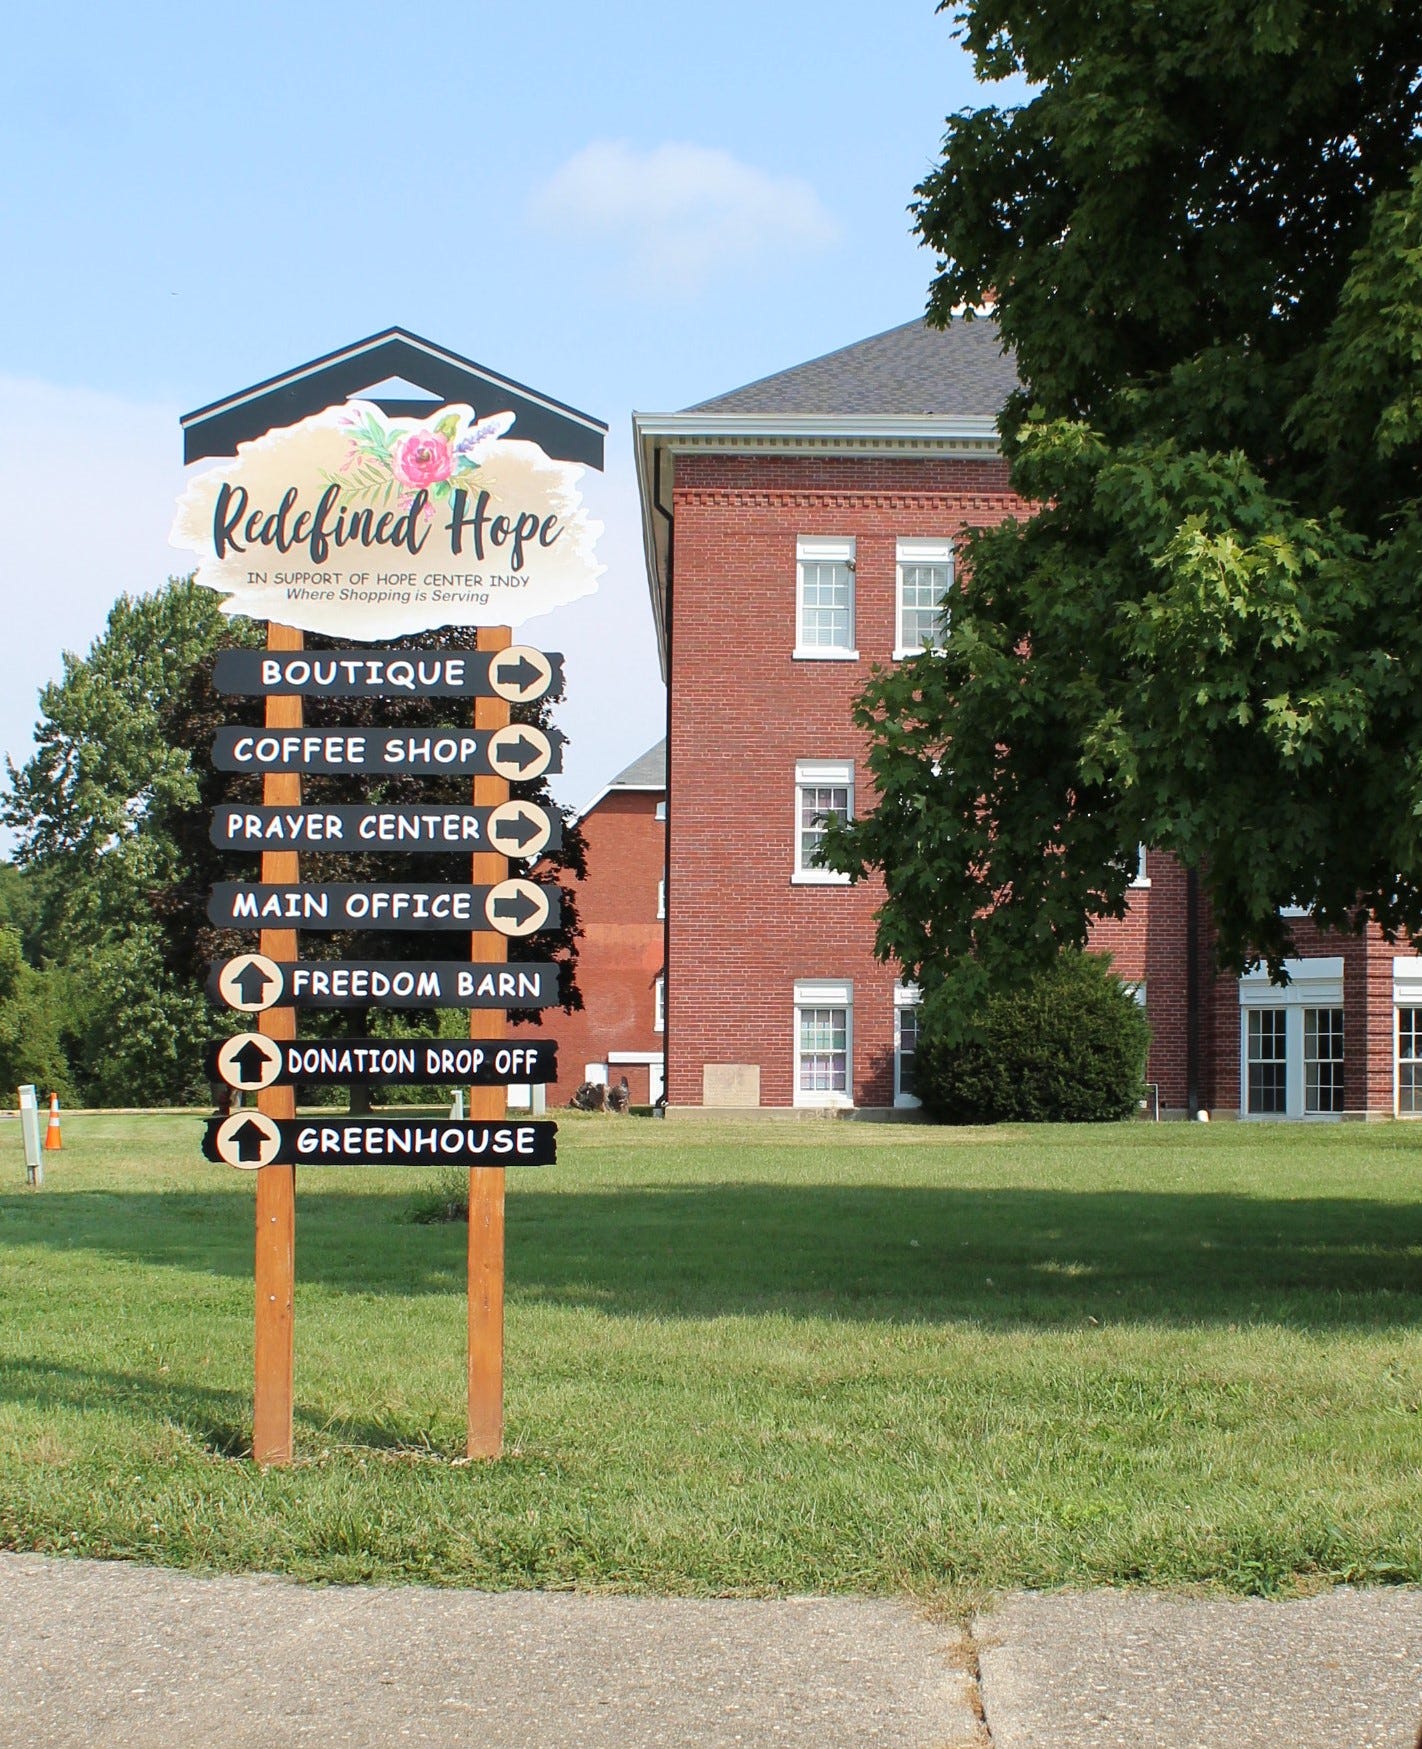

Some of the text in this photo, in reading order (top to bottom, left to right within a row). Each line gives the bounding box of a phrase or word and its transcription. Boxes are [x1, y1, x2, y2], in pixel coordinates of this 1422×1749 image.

[213, 482, 564, 573] Redefined Hope
[247, 572, 530, 588] IN SUPPORT OF HOPE CENTER INDY
[286, 588, 489, 605] Where Shopping is Serving
[261, 659, 465, 690] BOUTIQUE
[233, 737, 477, 763] COFFEE SHOP
[226, 814, 480, 840] PRAYER CENTER
[232, 893, 471, 919] MAIN OFFICE
[292, 970, 540, 997] FREEDOM BARN
[287, 1048, 538, 1075] DONATION DROP OFF
[296, 1127, 536, 1154] GREENHOUSE
